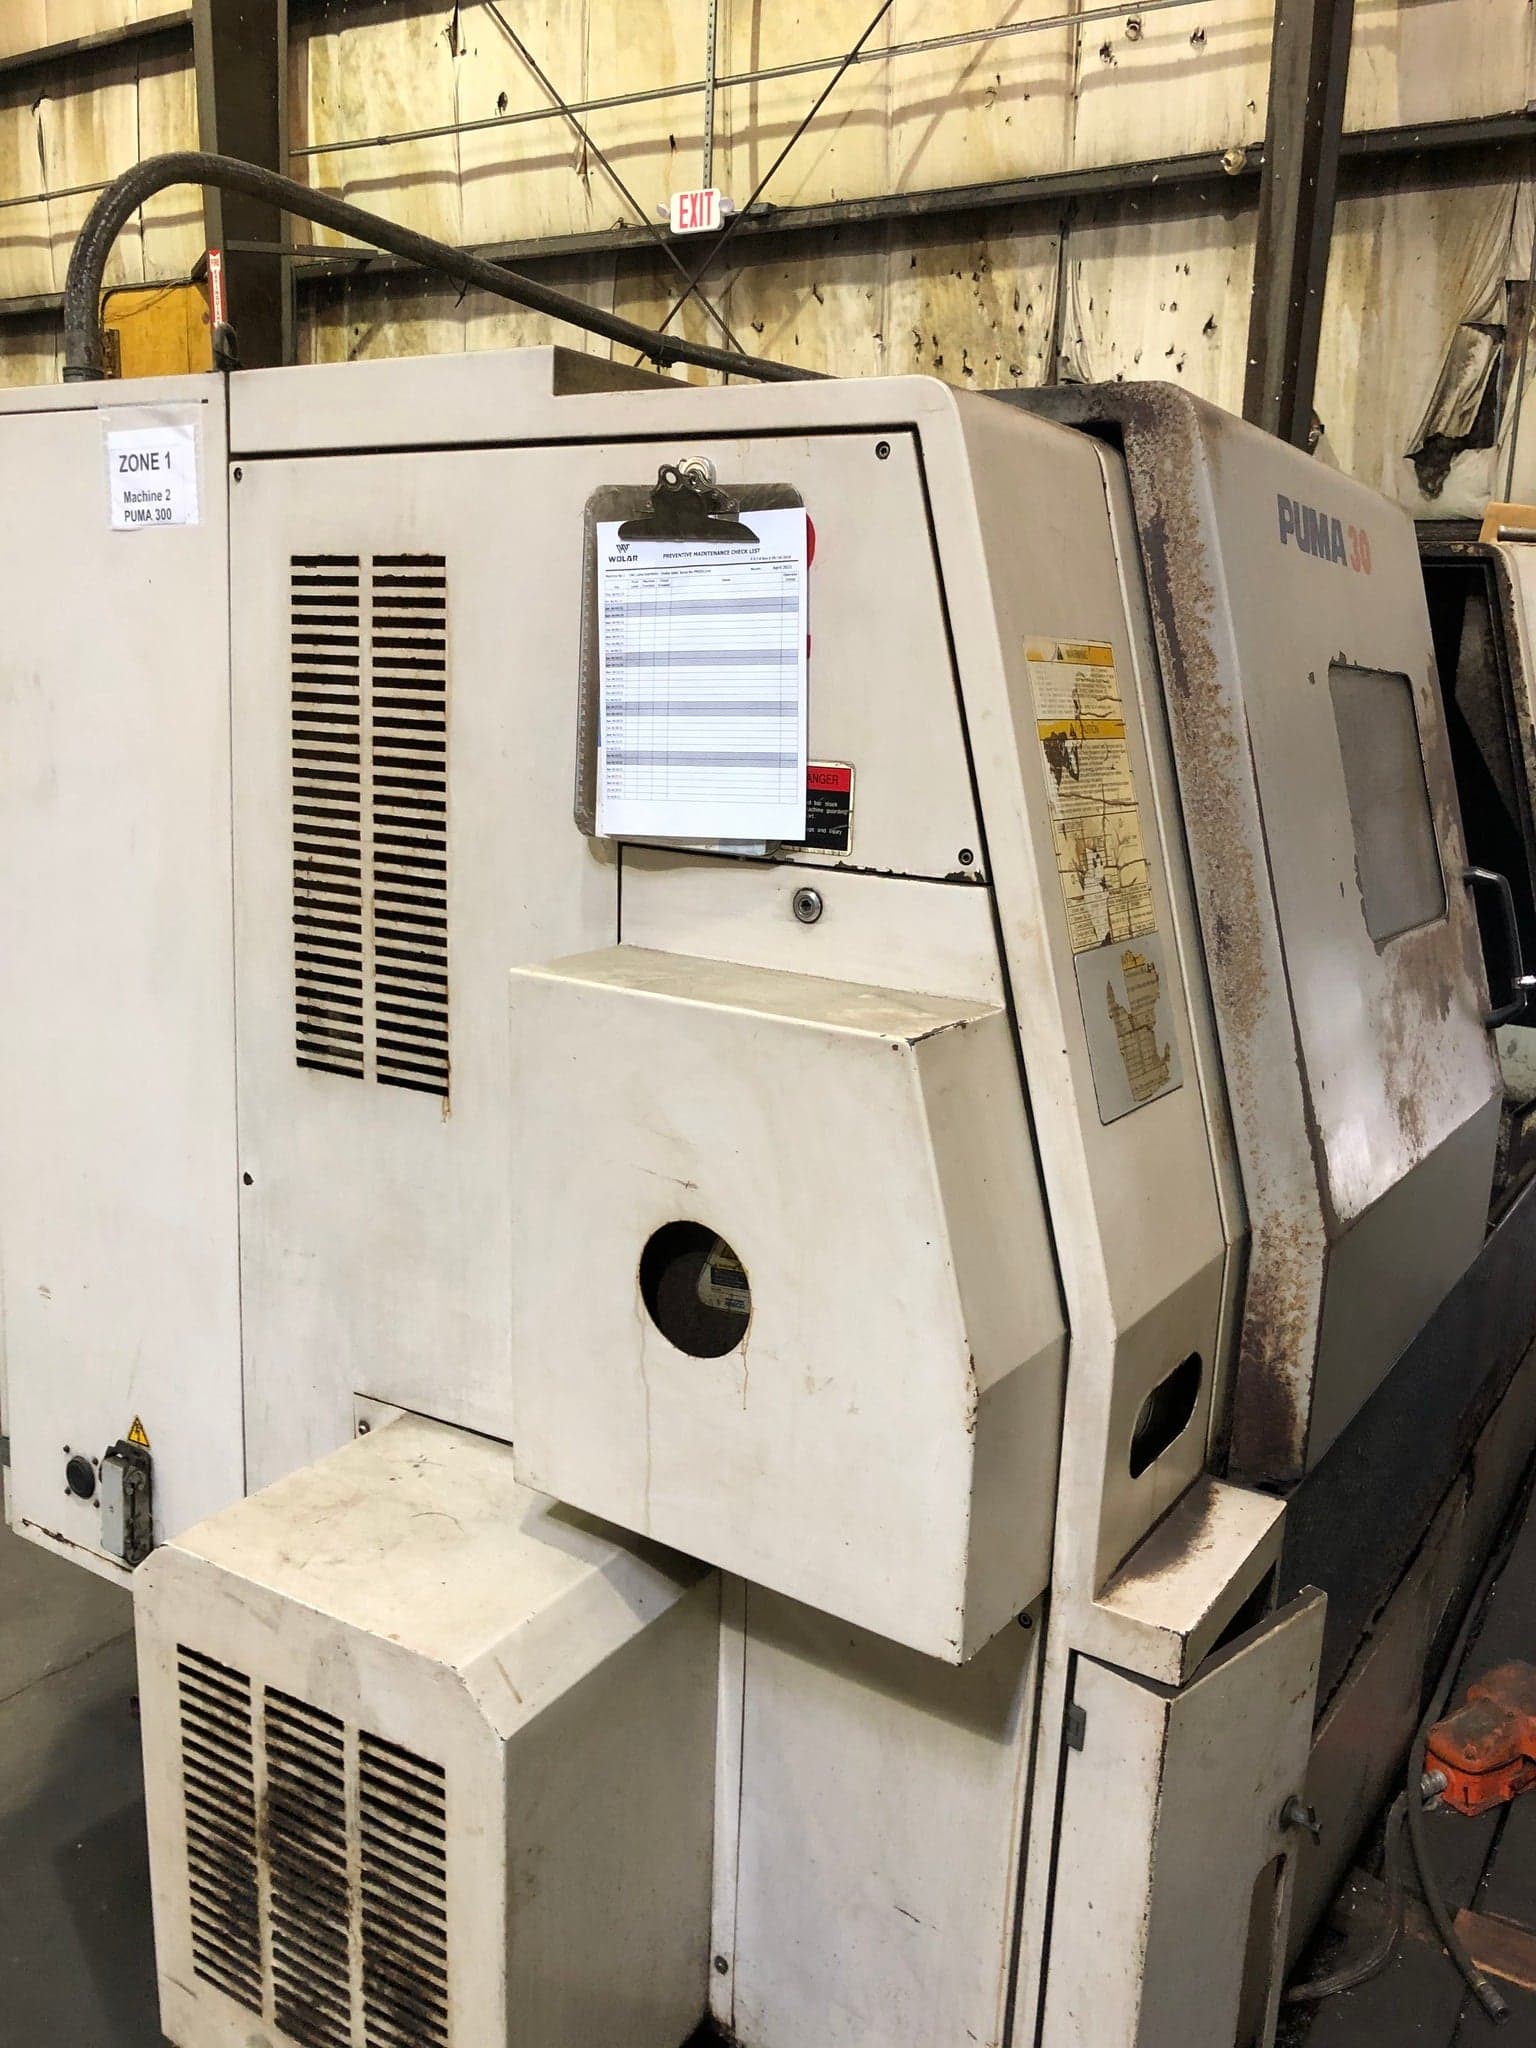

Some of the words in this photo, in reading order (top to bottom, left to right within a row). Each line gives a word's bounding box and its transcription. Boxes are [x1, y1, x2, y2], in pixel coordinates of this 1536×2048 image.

[679, 191, 714, 229] EXIT
[119, 452, 160, 473] ZONE
[164, 451, 171, 469] 1
[123, 490, 163, 503] Machine
[165, 488, 172, 501] 2
[124, 509, 153, 522] PUMA
[155, 508, 172, 521] 300
[1276, 493, 1348, 567] PUMA
[608, 554, 639, 563] WOLAR
[662, 551, 693, 559] PREVENTIVE
[693, 549, 730, 557] MAINTENANCE
[807, 773, 839, 785] ANGER
